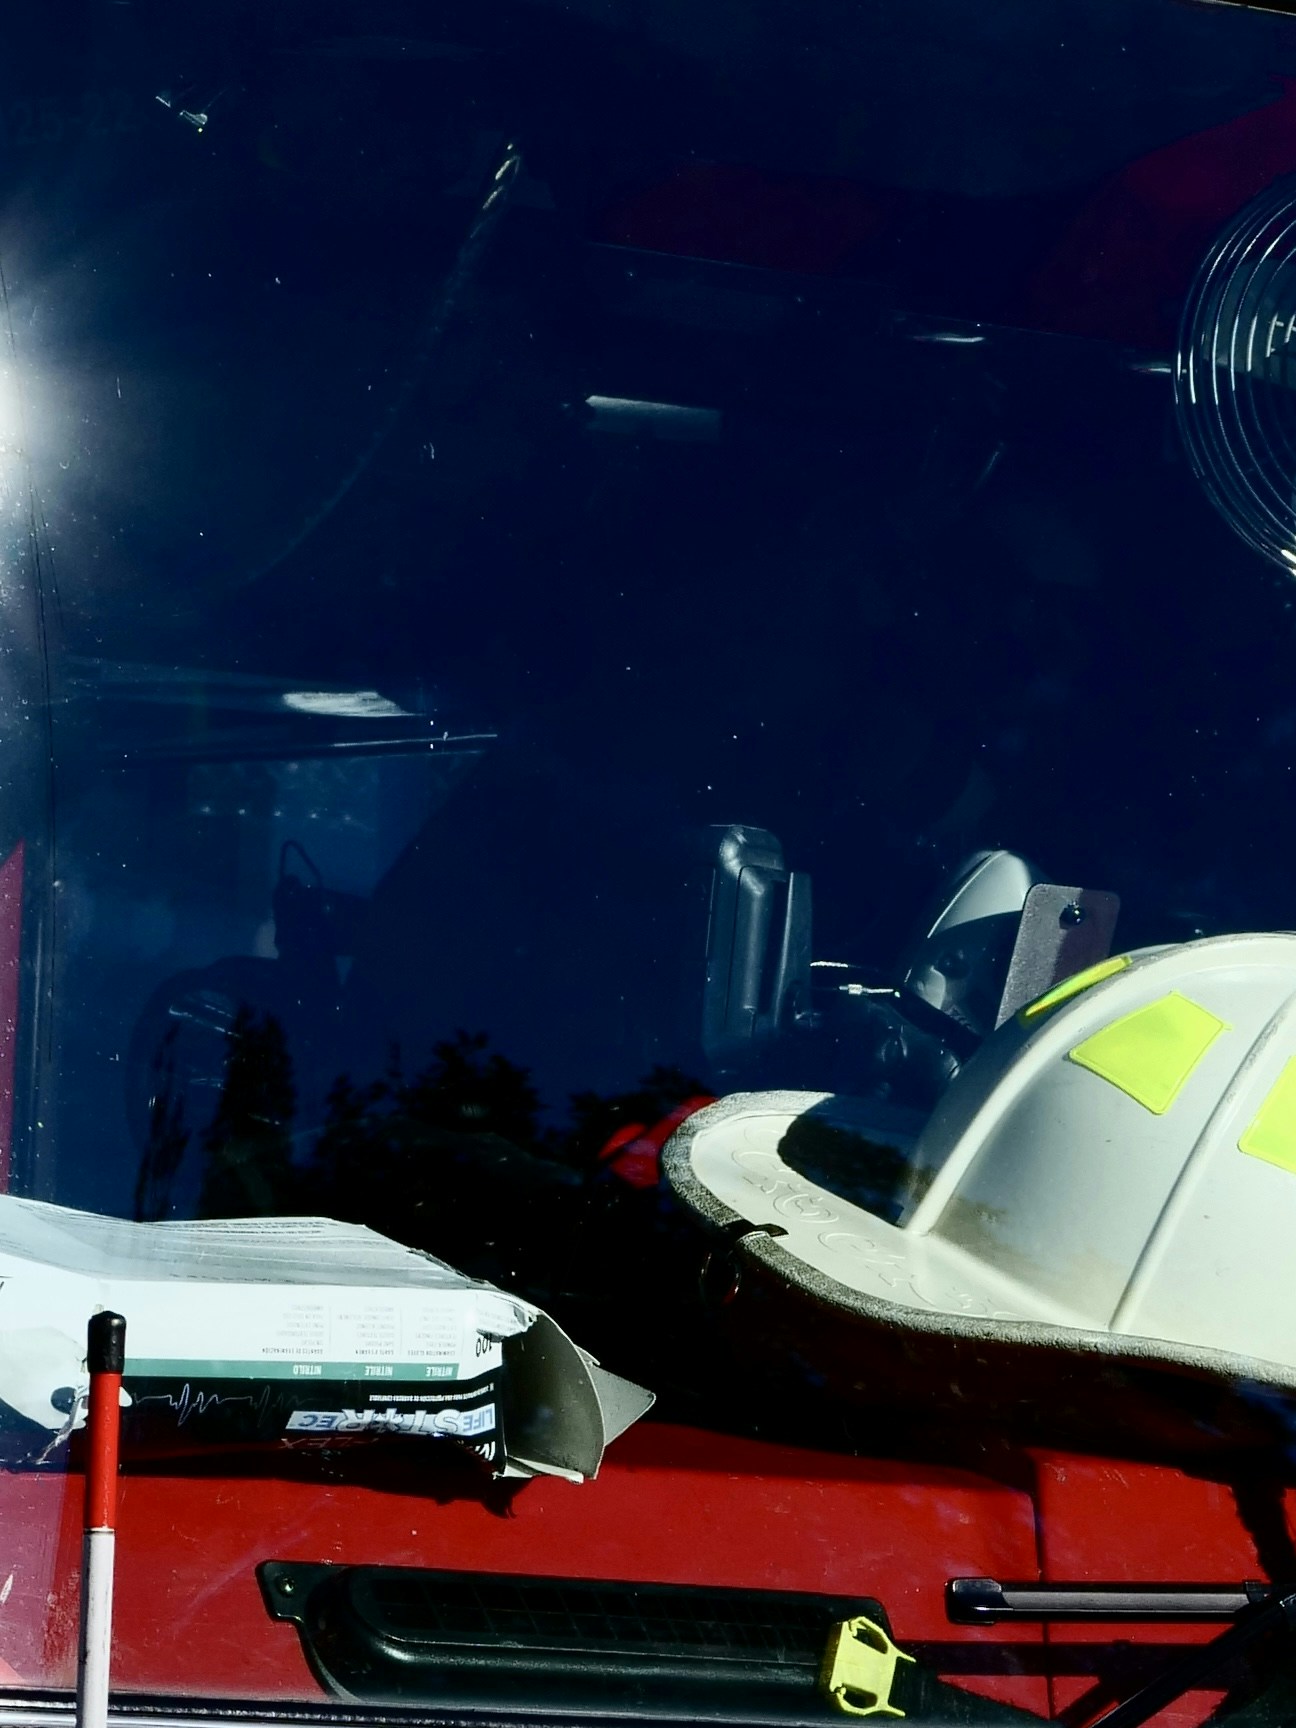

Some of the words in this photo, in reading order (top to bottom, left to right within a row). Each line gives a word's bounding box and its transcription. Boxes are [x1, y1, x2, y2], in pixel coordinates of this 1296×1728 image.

[292, 1364, 323, 1376] NITRILO
[365, 1365, 394, 1377] NITRILE
[426, 1366, 454, 1378] NITRILE
